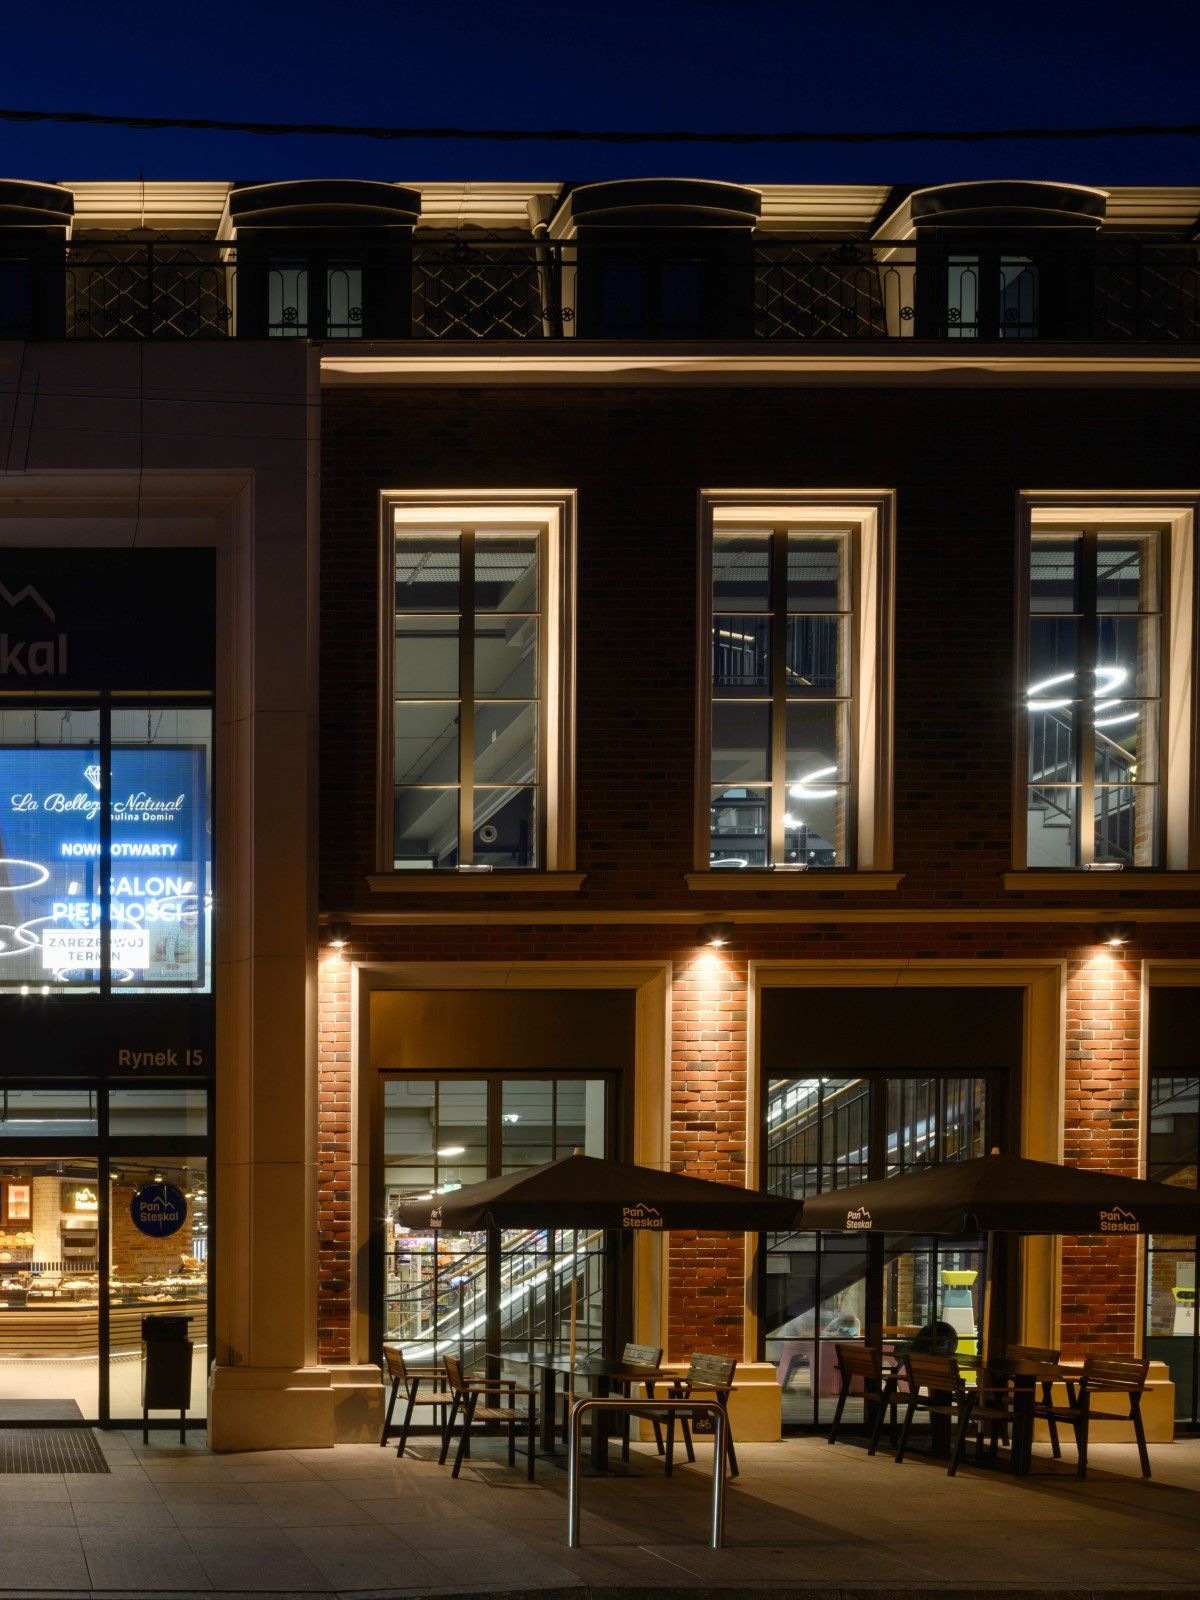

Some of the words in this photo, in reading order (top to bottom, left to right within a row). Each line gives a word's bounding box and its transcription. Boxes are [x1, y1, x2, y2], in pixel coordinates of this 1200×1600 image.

[11, 793, 39, 812] La
[44, 793, 101, 820] Bellez
[113, 791, 186, 812] Natural
[110, 812, 139, 821] aulina
[143, 813, 174, 821] Domin
[110, 843, 178, 856] OTWARTY
[48, 938, 144, 948] ZAREZEWUJ
[68, 951, 121, 961] TERN
[118, 1048, 178, 1069] Rynek
[186, 1049, 203, 1066] 15
[140, 1202, 160, 1211] Pan
[622, 1207, 644, 1216] Pan
[140, 1212, 179, 1222] Steskal
[847, 1211, 861, 1219] Pan
[1100, 1211, 1120, 1220] Pan
[622, 1217, 663, 1227] Steskal
[846, 1220, 873, 1229] Steskal
[1100, 1221, 1140, 1231] Steskal
